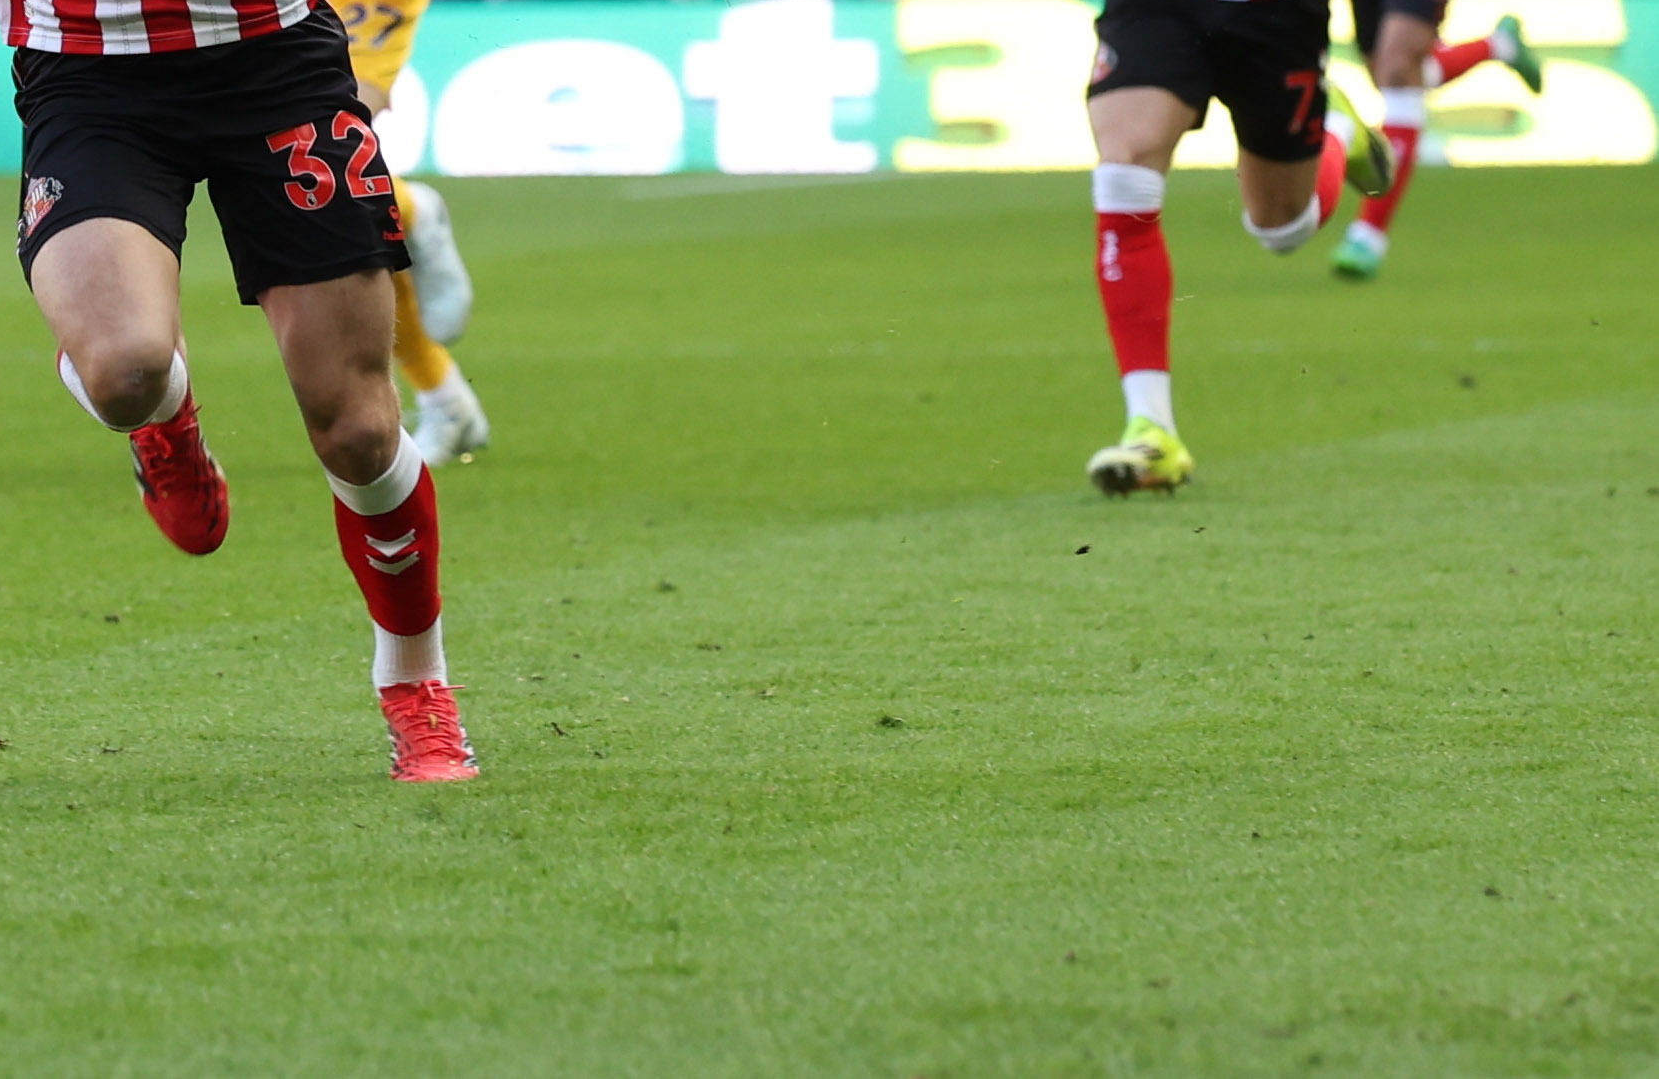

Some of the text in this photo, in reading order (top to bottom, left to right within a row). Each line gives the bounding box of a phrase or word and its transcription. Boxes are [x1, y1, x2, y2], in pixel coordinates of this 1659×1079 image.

[344, 3, 406, 47] 27
[1285, 69, 1318, 135] 7
[266, 110, 393, 211] 32
